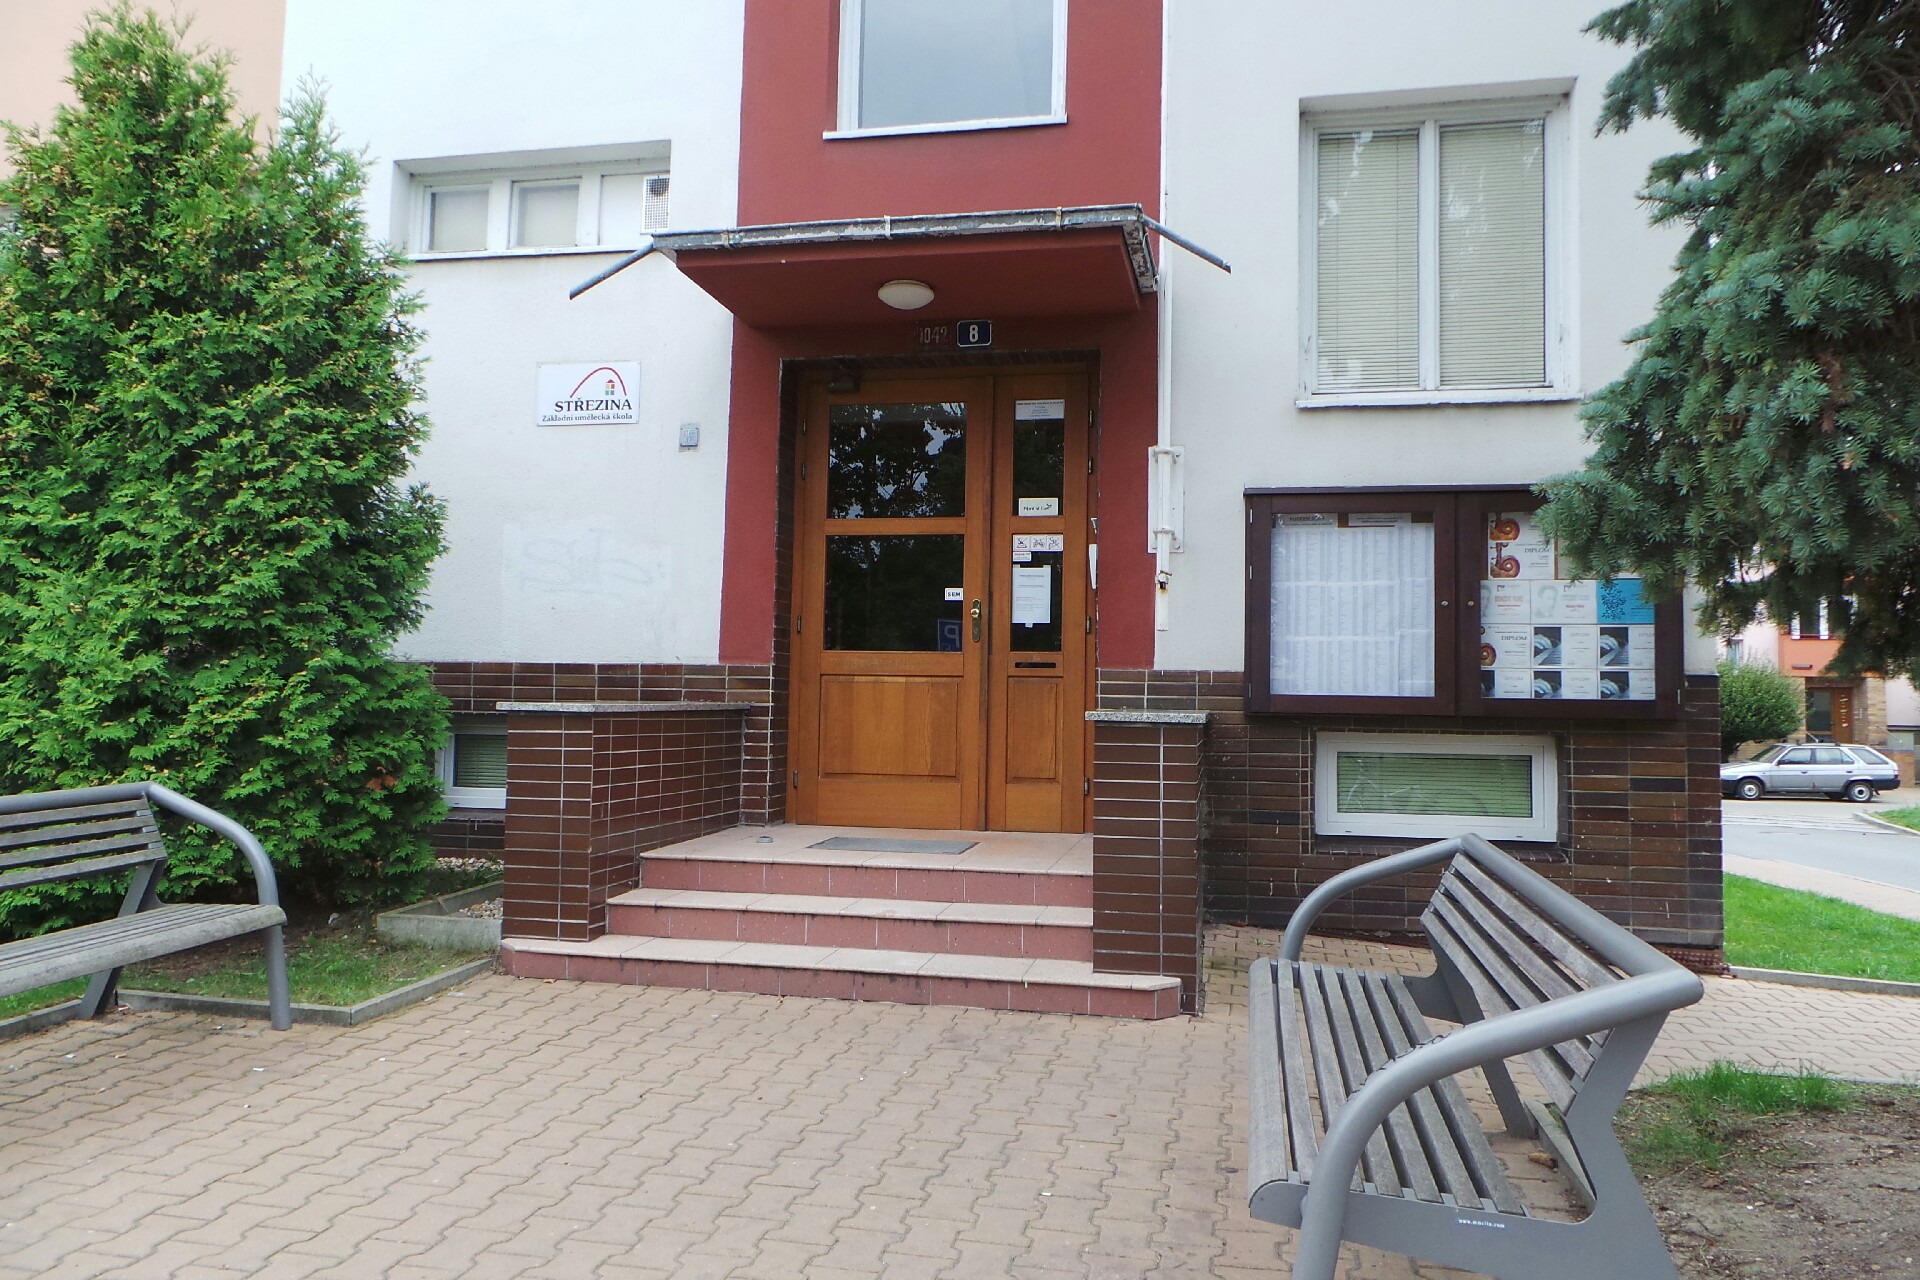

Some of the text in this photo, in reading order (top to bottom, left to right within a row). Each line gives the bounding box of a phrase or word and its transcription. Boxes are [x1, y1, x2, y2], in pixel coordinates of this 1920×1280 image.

[969, 324, 979, 342] 8
[554, 397, 632, 412] STŘEZINA
[542, 412, 633, 422] Základní umělecká škola
